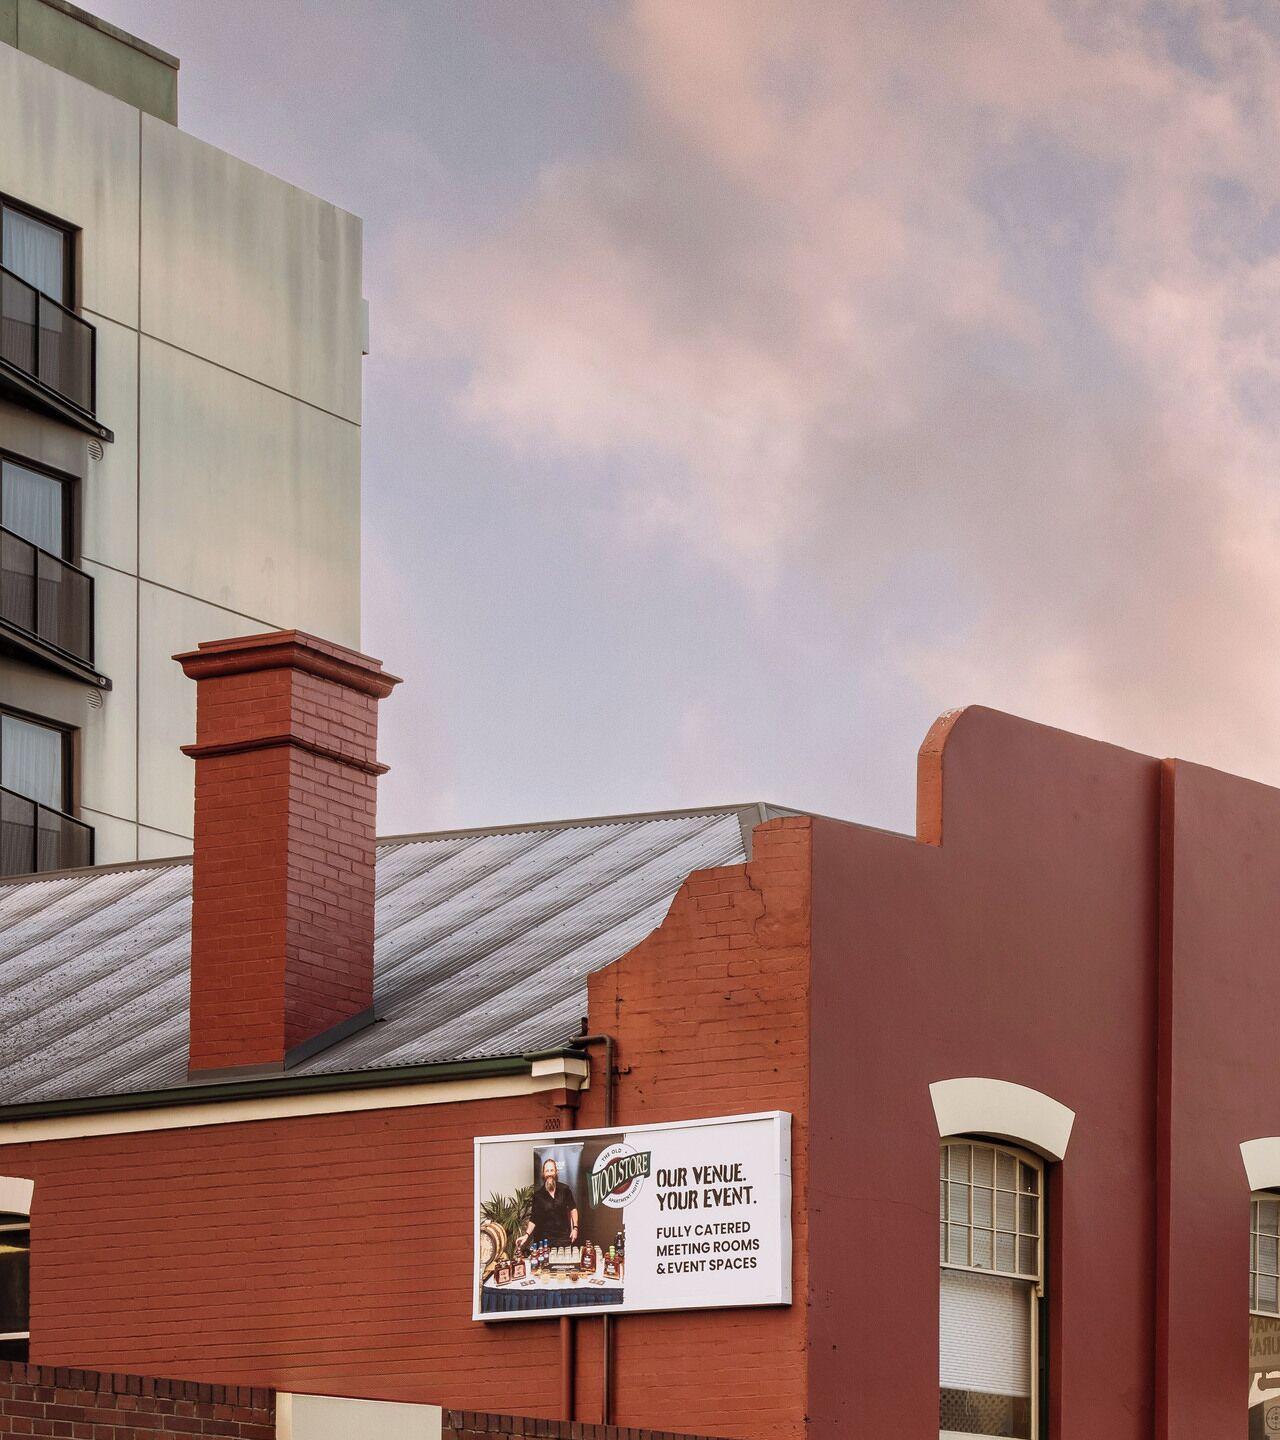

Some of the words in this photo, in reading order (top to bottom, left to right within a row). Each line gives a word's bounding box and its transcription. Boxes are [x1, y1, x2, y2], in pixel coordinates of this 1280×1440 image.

[602, 1152, 610, 1162] THE
[591, 1153, 649, 1206] WOOLSTORE
[656, 1167, 688, 1188] OUR
[692, 1163, 747, 1185] VENUE.
[656, 1190, 698, 1211] YOUR
[703, 1186, 757, 1208] EVENT.
[656, 1225, 692, 1239] FULLY
[694, 1221, 751, 1236] CATERED
[656, 1242, 711, 1257] MEETING
[713, 1239, 760, 1253] ROOMS
[656, 1263, 666, 1275] &
[667, 1260, 707, 1274] EVENT
[709, 1257, 757, 1271] SPACES
